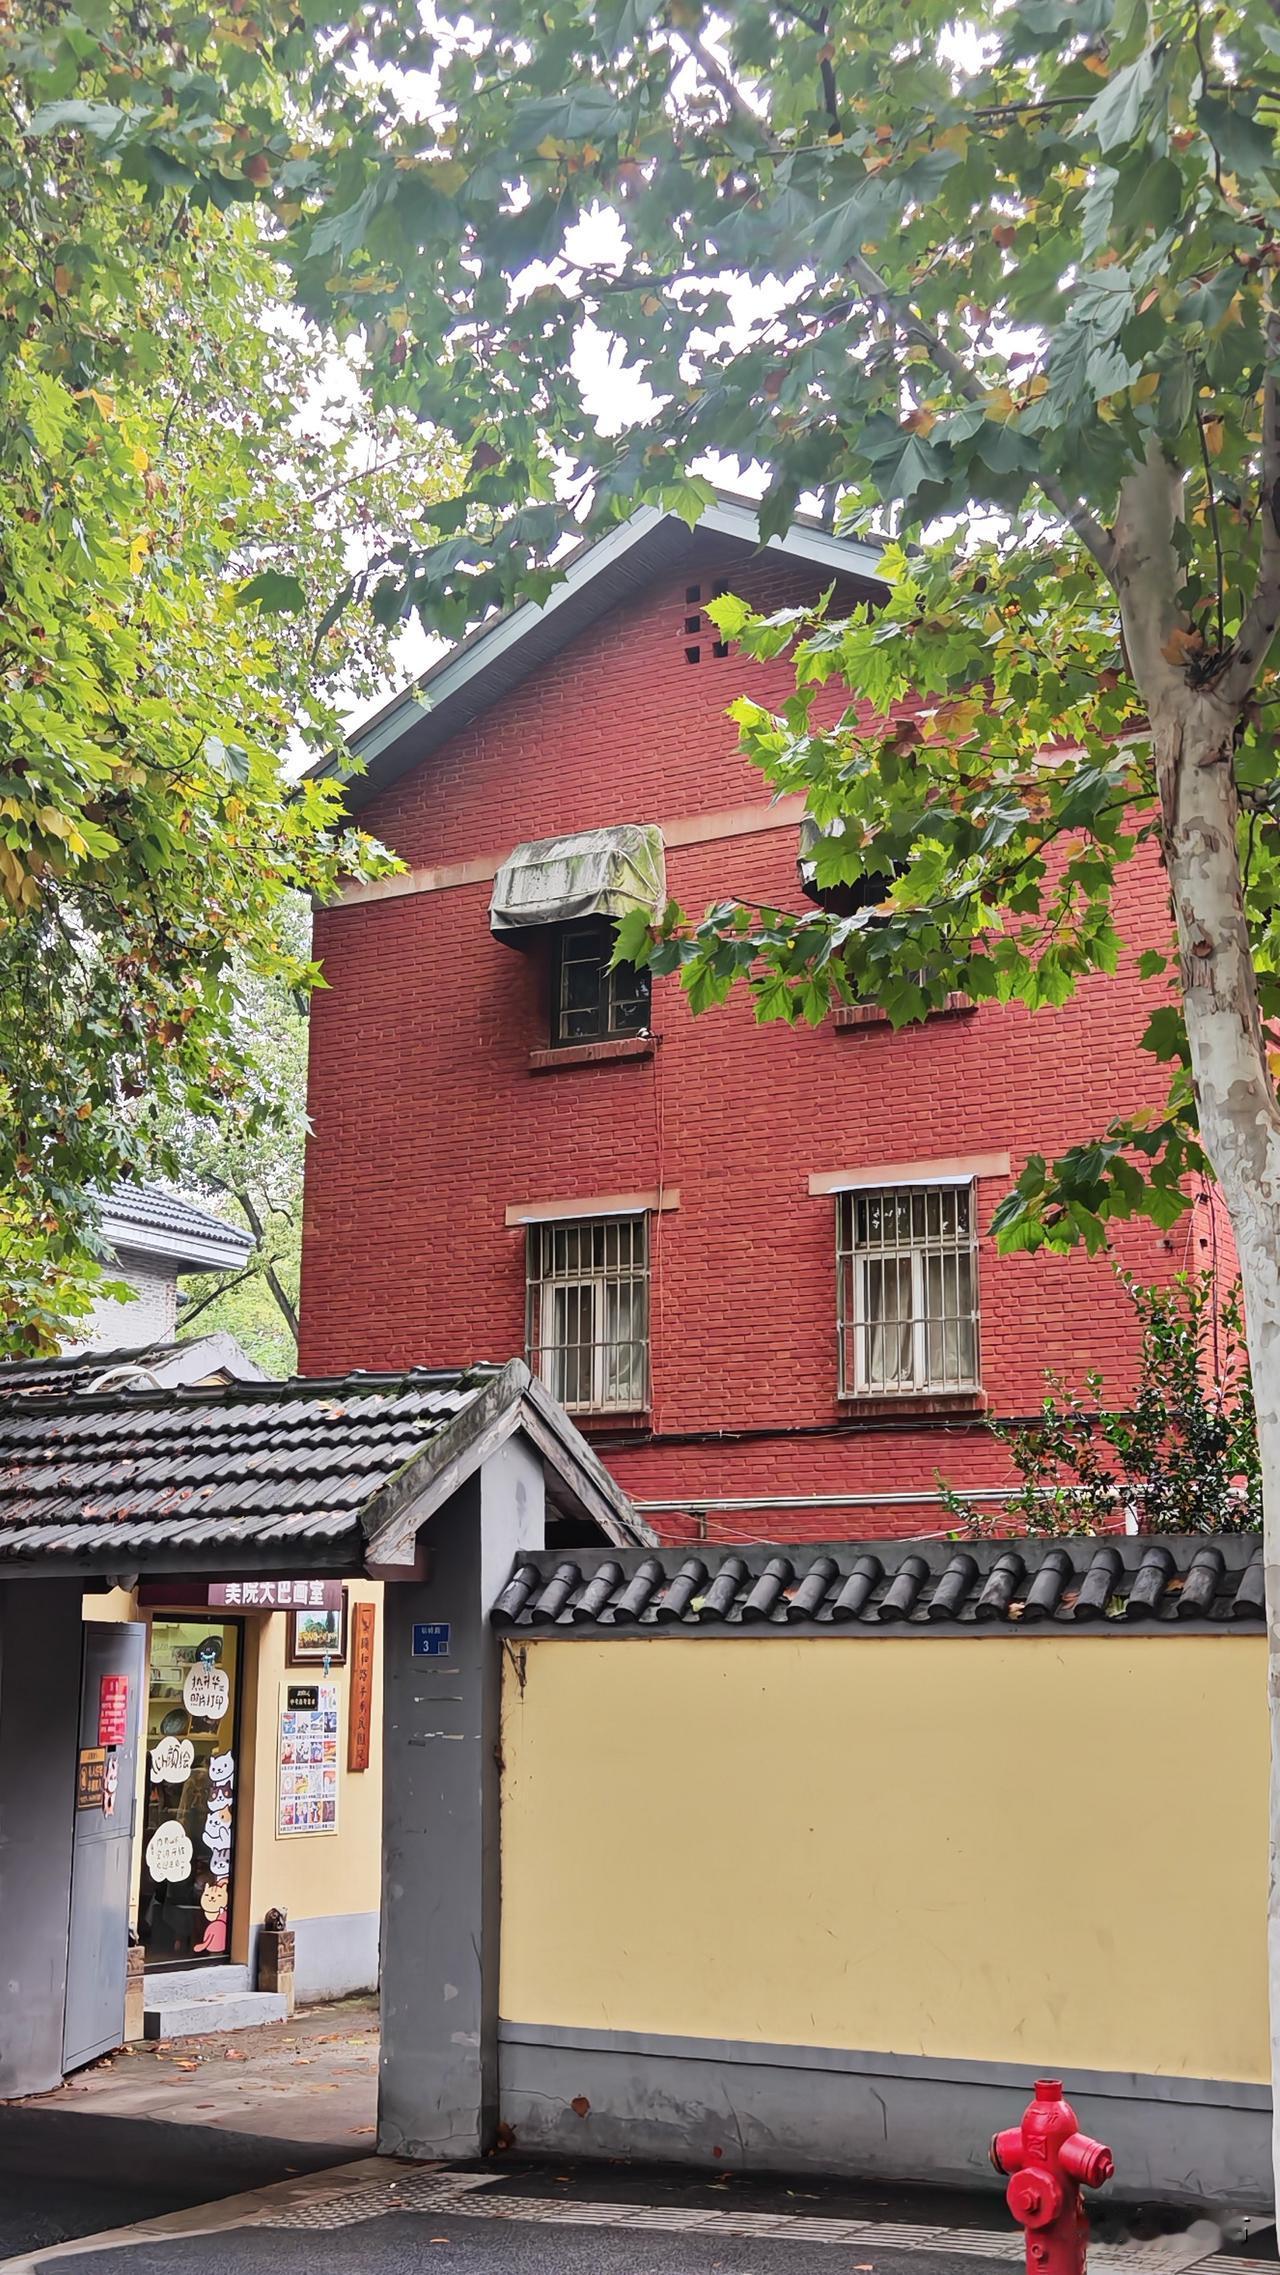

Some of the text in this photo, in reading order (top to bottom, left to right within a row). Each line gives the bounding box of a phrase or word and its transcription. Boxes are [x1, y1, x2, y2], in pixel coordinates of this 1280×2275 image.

[225, 1580, 324, 1605] 美院大巴画室
[423, 1640, 430, 1652] 3
